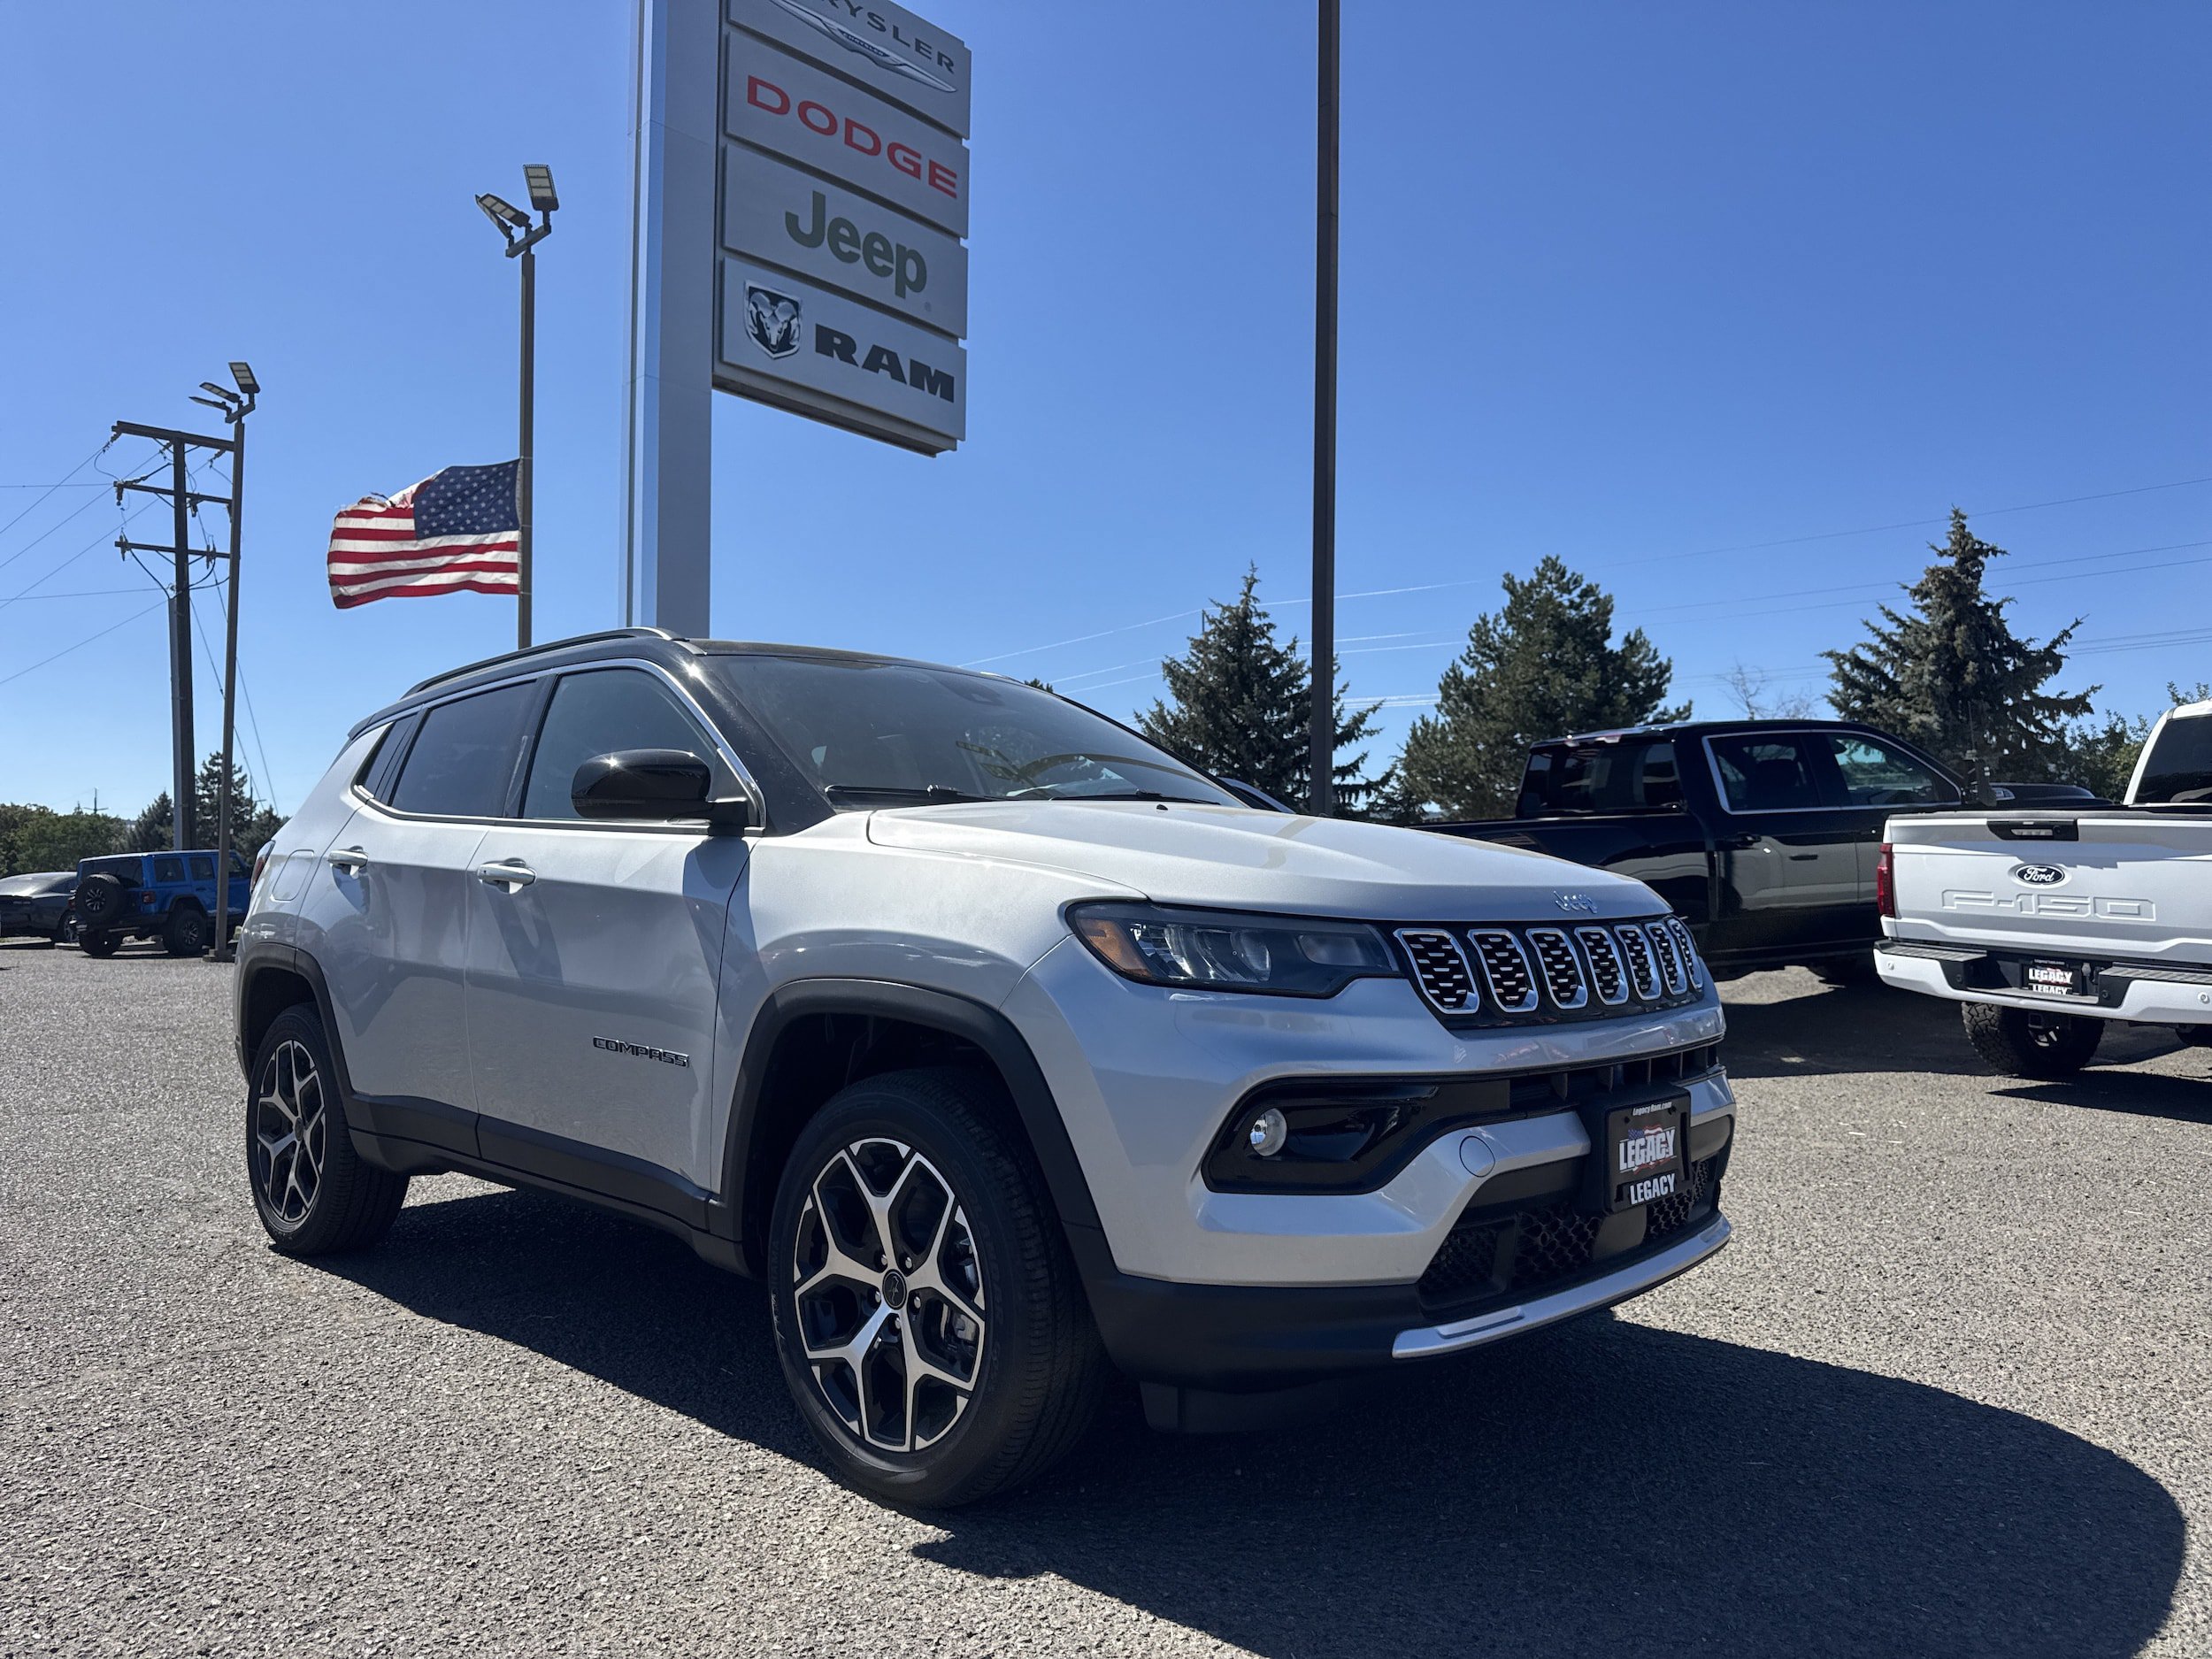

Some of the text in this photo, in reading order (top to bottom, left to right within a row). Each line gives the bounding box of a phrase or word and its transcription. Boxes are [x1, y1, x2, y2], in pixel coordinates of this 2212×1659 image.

[747, 75, 957, 199] DODGE
[785, 190, 927, 299] Jeep
[815, 323, 955, 403] RAM
[2024, 866, 2055, 882] Ford
[1553, 890, 1598, 914] Jeep
[1942, 889, 2157, 922] F-150
[2028, 968, 2073, 984] LEGACY
[2032, 984, 2069, 995] LEGACY
[593, 1036, 690, 1068] COMPASS
[1619, 1128, 1676, 1171] LEGACY
[1630, 1173, 1676, 1205] LEGACY
